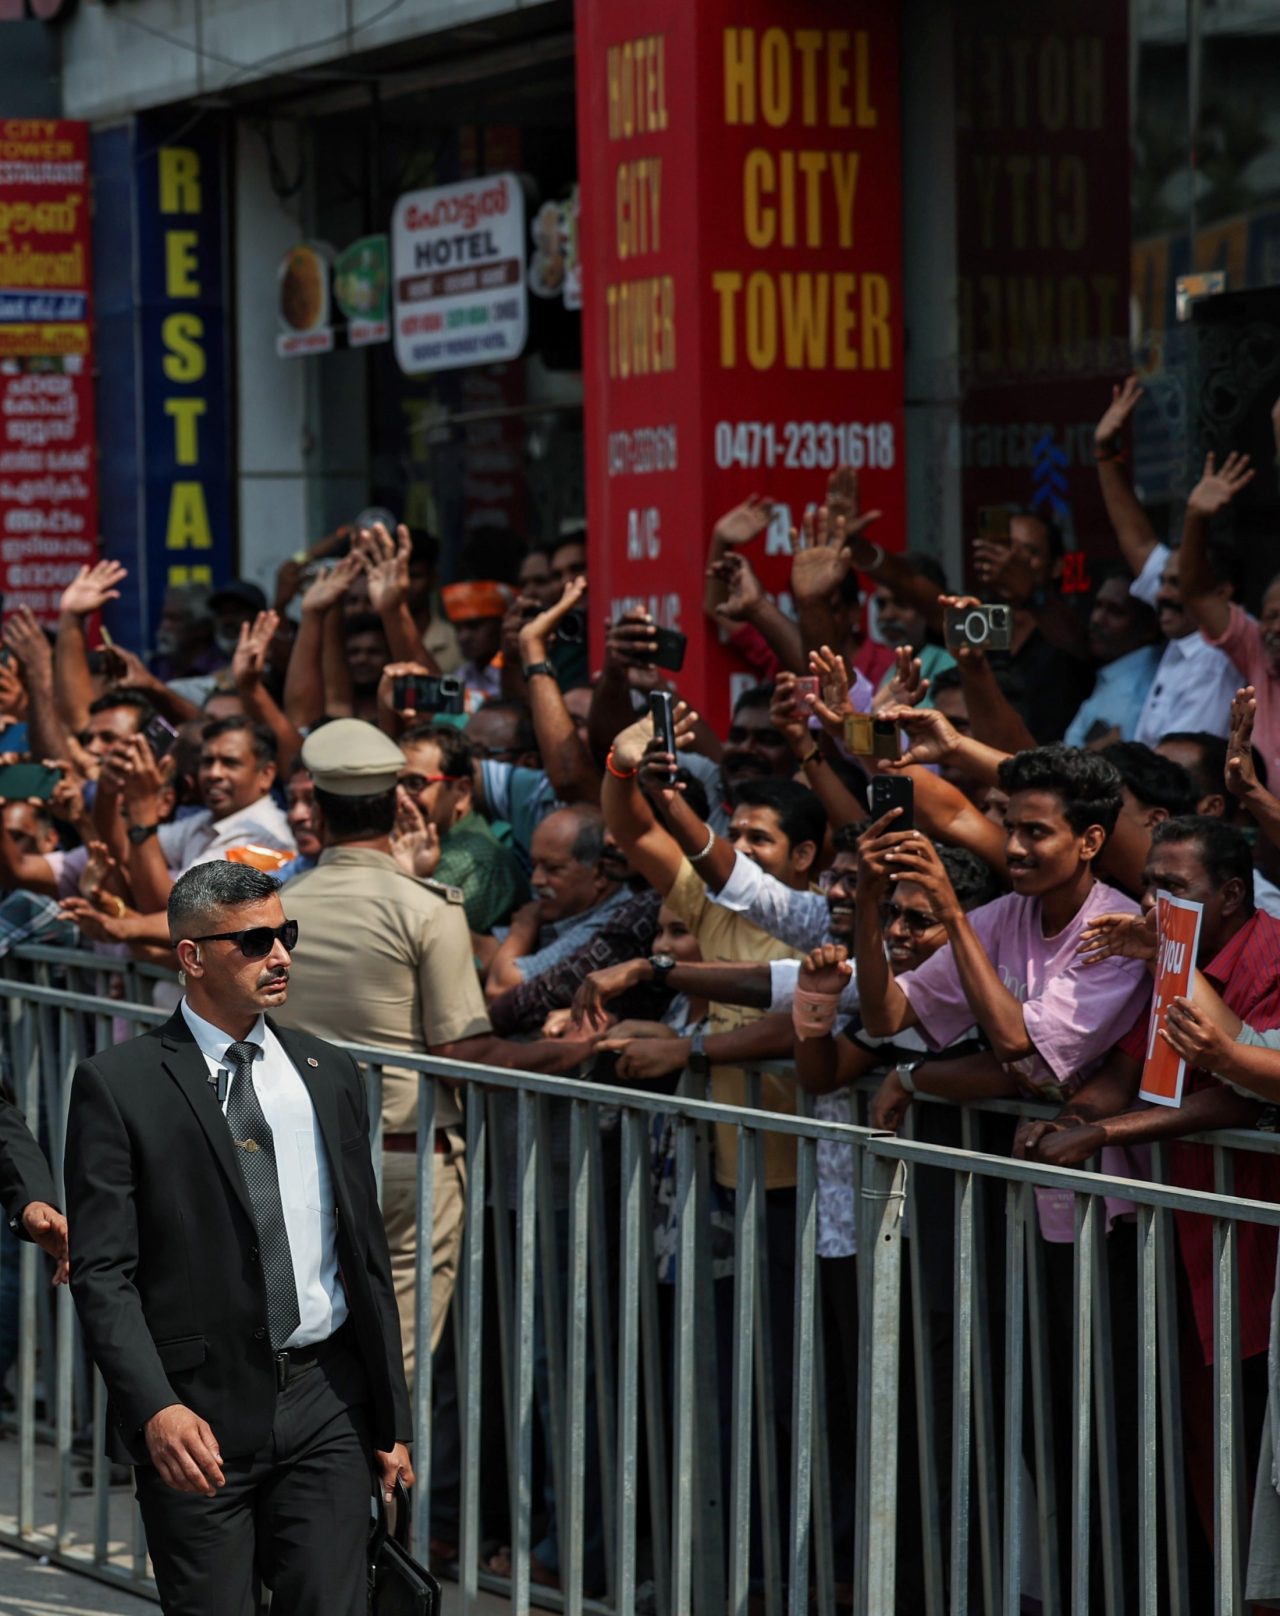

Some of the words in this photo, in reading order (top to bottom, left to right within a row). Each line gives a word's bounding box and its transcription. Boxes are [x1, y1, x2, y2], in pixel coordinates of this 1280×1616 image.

[607, 34, 668, 140] HOTEL
[723, 27, 877, 128] HOTEL
[4, 121, 57, 140] CITY
[617, 156, 663, 260] CITY
[742, 147, 861, 248] CITY
[414, 229, 500, 270] HOTEL
[712, 270, 892, 371] TOWER
[714, 421, 897, 470] 0471-2331618
[627, 506, 661, 561] A/C
[1160, 939, 1186, 980] you
